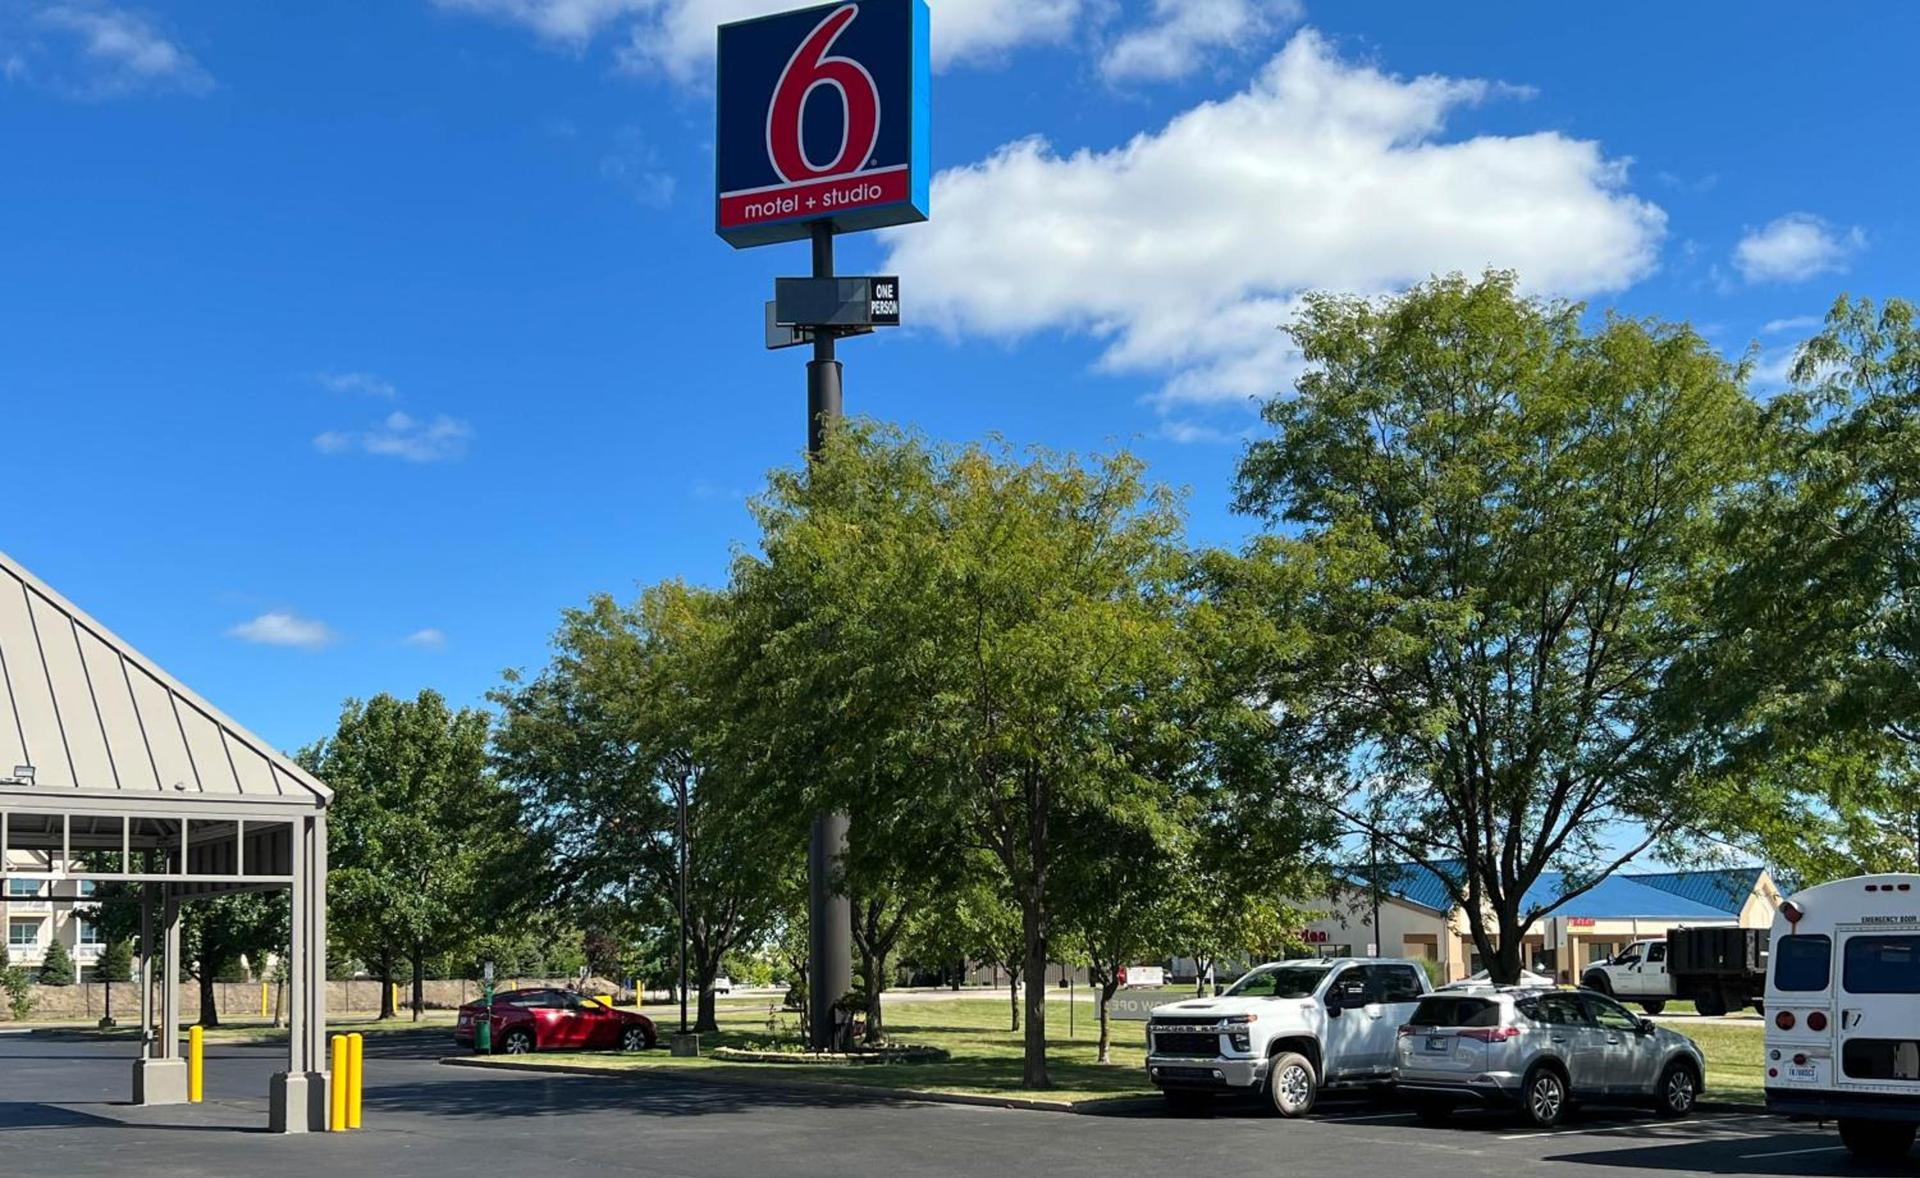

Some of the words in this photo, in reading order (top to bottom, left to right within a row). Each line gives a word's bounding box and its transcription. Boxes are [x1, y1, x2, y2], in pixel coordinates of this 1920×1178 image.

[766, 3, 880, 186] 6
[744, 194, 798, 219] motel
[822, 183, 882, 206] studio
[876, 284, 894, 299] ONE
[871, 300, 898, 315] PERSON
[1861, 915, 1898, 924] EMERGENCY
